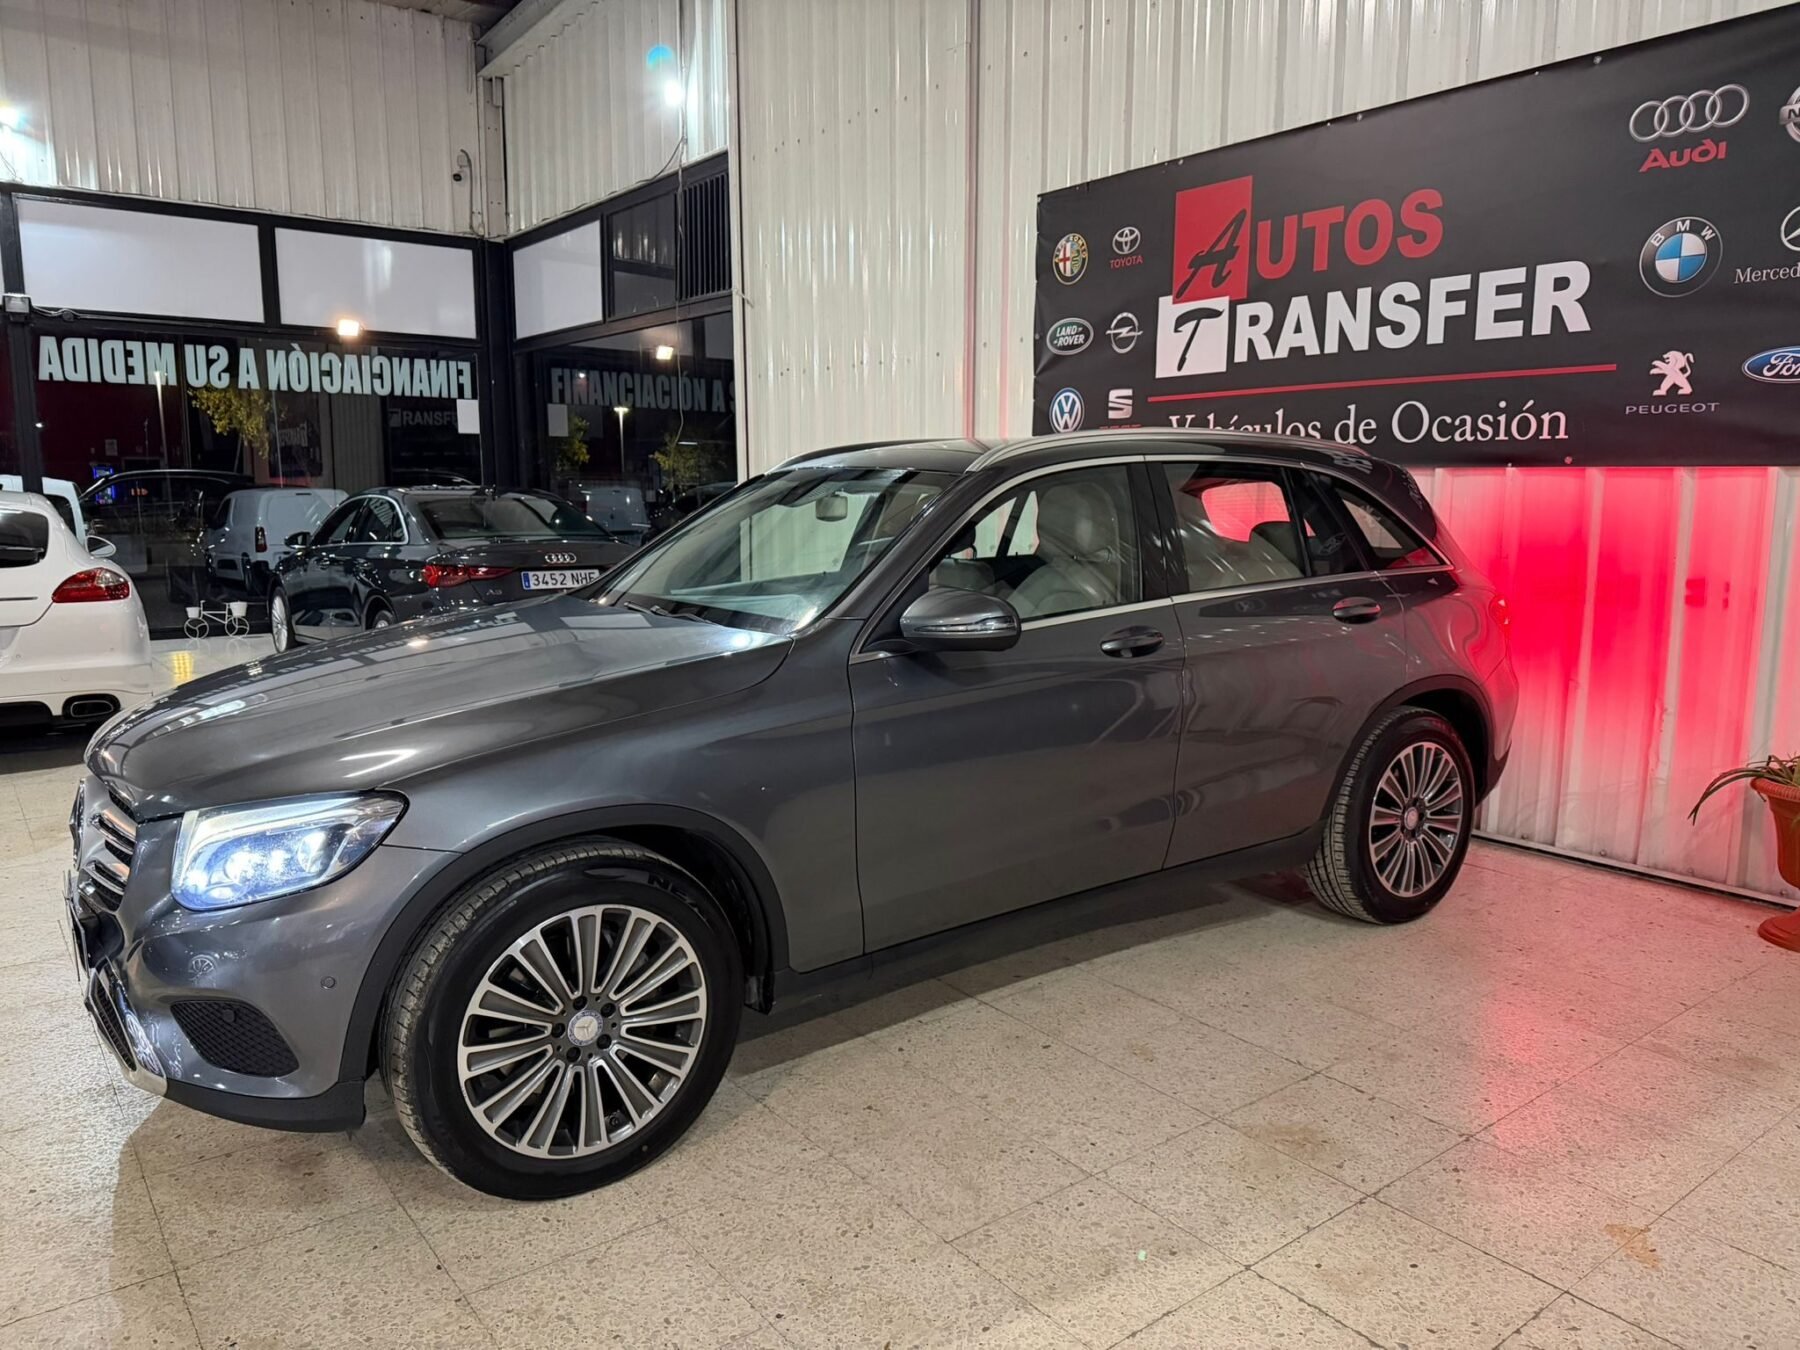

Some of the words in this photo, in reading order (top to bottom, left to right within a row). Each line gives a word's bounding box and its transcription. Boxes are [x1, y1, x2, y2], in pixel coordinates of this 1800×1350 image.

[1638, 138, 1727, 173] Audi
[1650, 219, 1716, 247] BMW
[1176, 188, 1444, 300] AUTOS
[1109, 255, 1144, 269] TOYOTA
[1173, 260, 1592, 372] TRANSFER
[1056, 325, 1078, 337] LAND
[1057, 334, 1086, 347] ROVER
[1625, 402, 1720, 415] PEUGEOT
[1334, 404, 1377, 444] de
[1391, 399, 1569, 444] Ocasión
[532, 572, 567, 587] 3452
